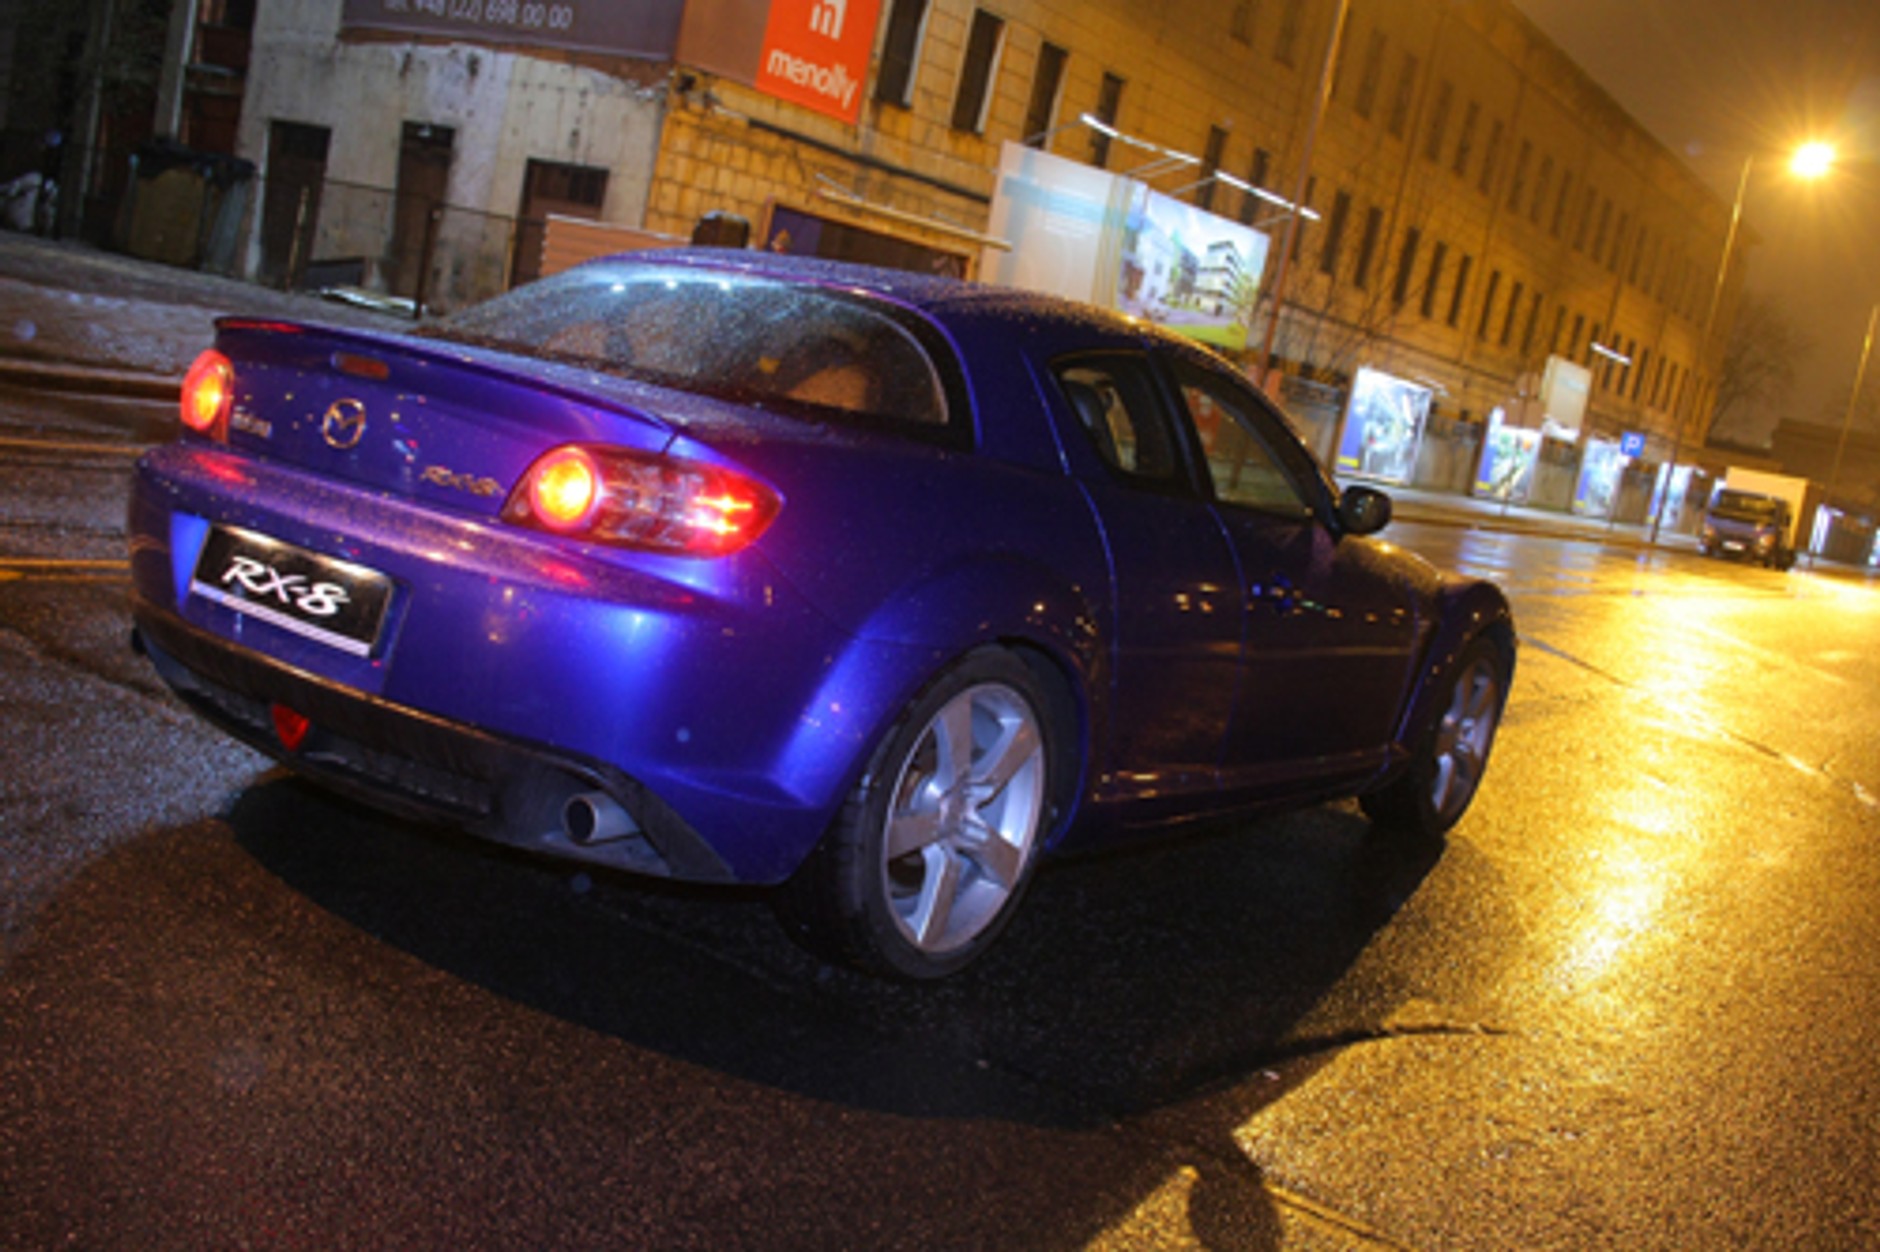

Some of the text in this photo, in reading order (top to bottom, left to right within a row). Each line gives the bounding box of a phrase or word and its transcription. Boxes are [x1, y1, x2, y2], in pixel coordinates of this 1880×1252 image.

[522, 3, 546, 28] 00
[548, 4, 574, 30] 00
[767, 48, 858, 111] menolly
[221, 555, 351, 615] RX-8
